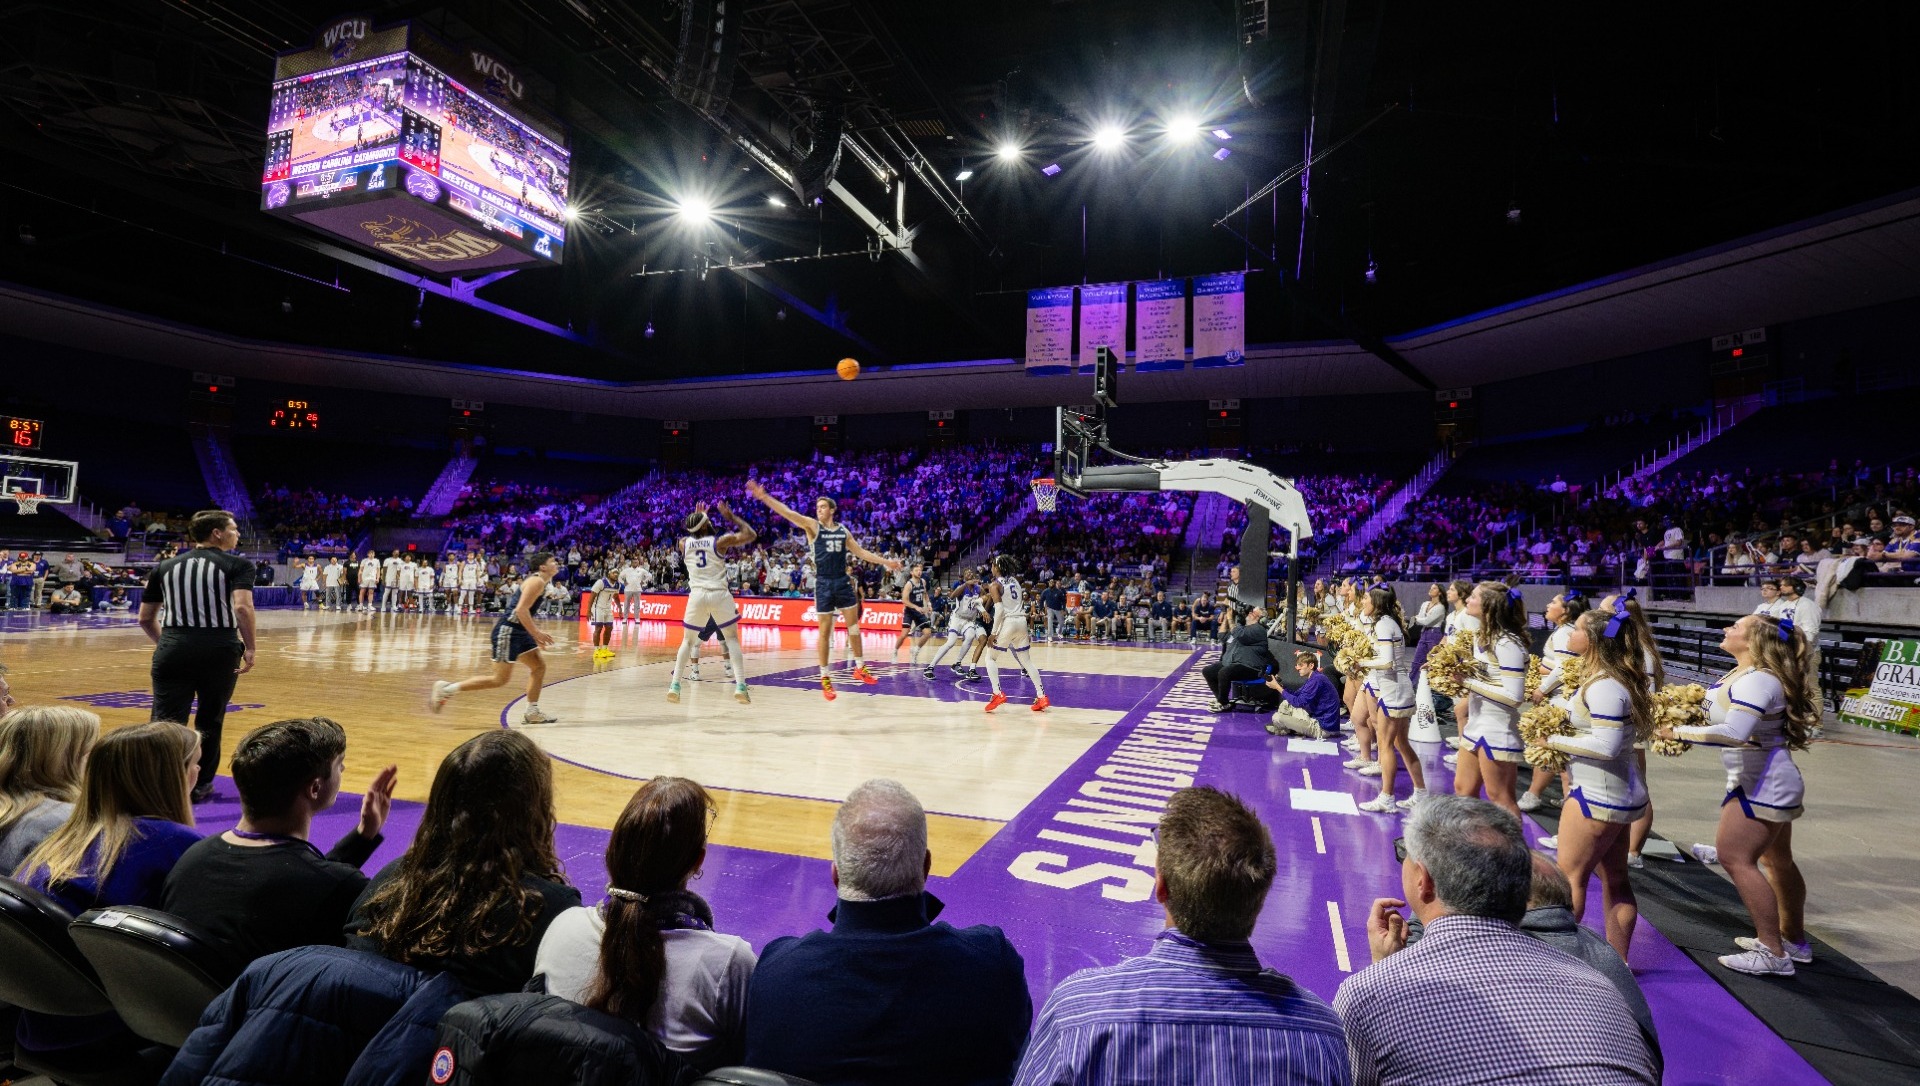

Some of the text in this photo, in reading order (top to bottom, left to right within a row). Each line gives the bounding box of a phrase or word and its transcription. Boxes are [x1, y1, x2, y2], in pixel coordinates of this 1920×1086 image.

[323, 20, 366, 48] WCU
[472, 52, 524, 99] WCU
[292, 161, 321, 176] WESTERN
[322, 155, 352, 170] CAROLINA
[354, 147, 397, 164] CATAMOUNTS
[302, 184, 309, 192] 17
[345, 176, 354, 184] 26
[320, 172, 335, 182] 8:57
[367, 180, 385, 190] SAM
[442, 168, 480, 196] WESTERN
[482, 189, 517, 215] CAROLINA
[518, 207, 561, 237] CATAMOUNTS
[456, 198, 466, 208] 17
[1733, 334, 1743, 344] N
[306, 413, 318, 421] 26
[10, 420, 39, 431] 8:57
[14, 430, 31, 446] 16
[1253, 488, 1283, 511] SPALDING
[826, 540, 842, 553] 35
[695, 549, 707, 568] 3
[1009, 585, 1018, 600] 5
[640, 600, 668, 615] Farm
[743, 603, 783, 621] WOLFE
[861, 608, 899, 625] Farm
[1886, 641, 1906, 662] B.
[1871, 685, 1909, 699] Landscapes
[1840, 698, 1909, 722] THE PERFECT
[1007, 711, 1218, 903] CATAMOUNTS
